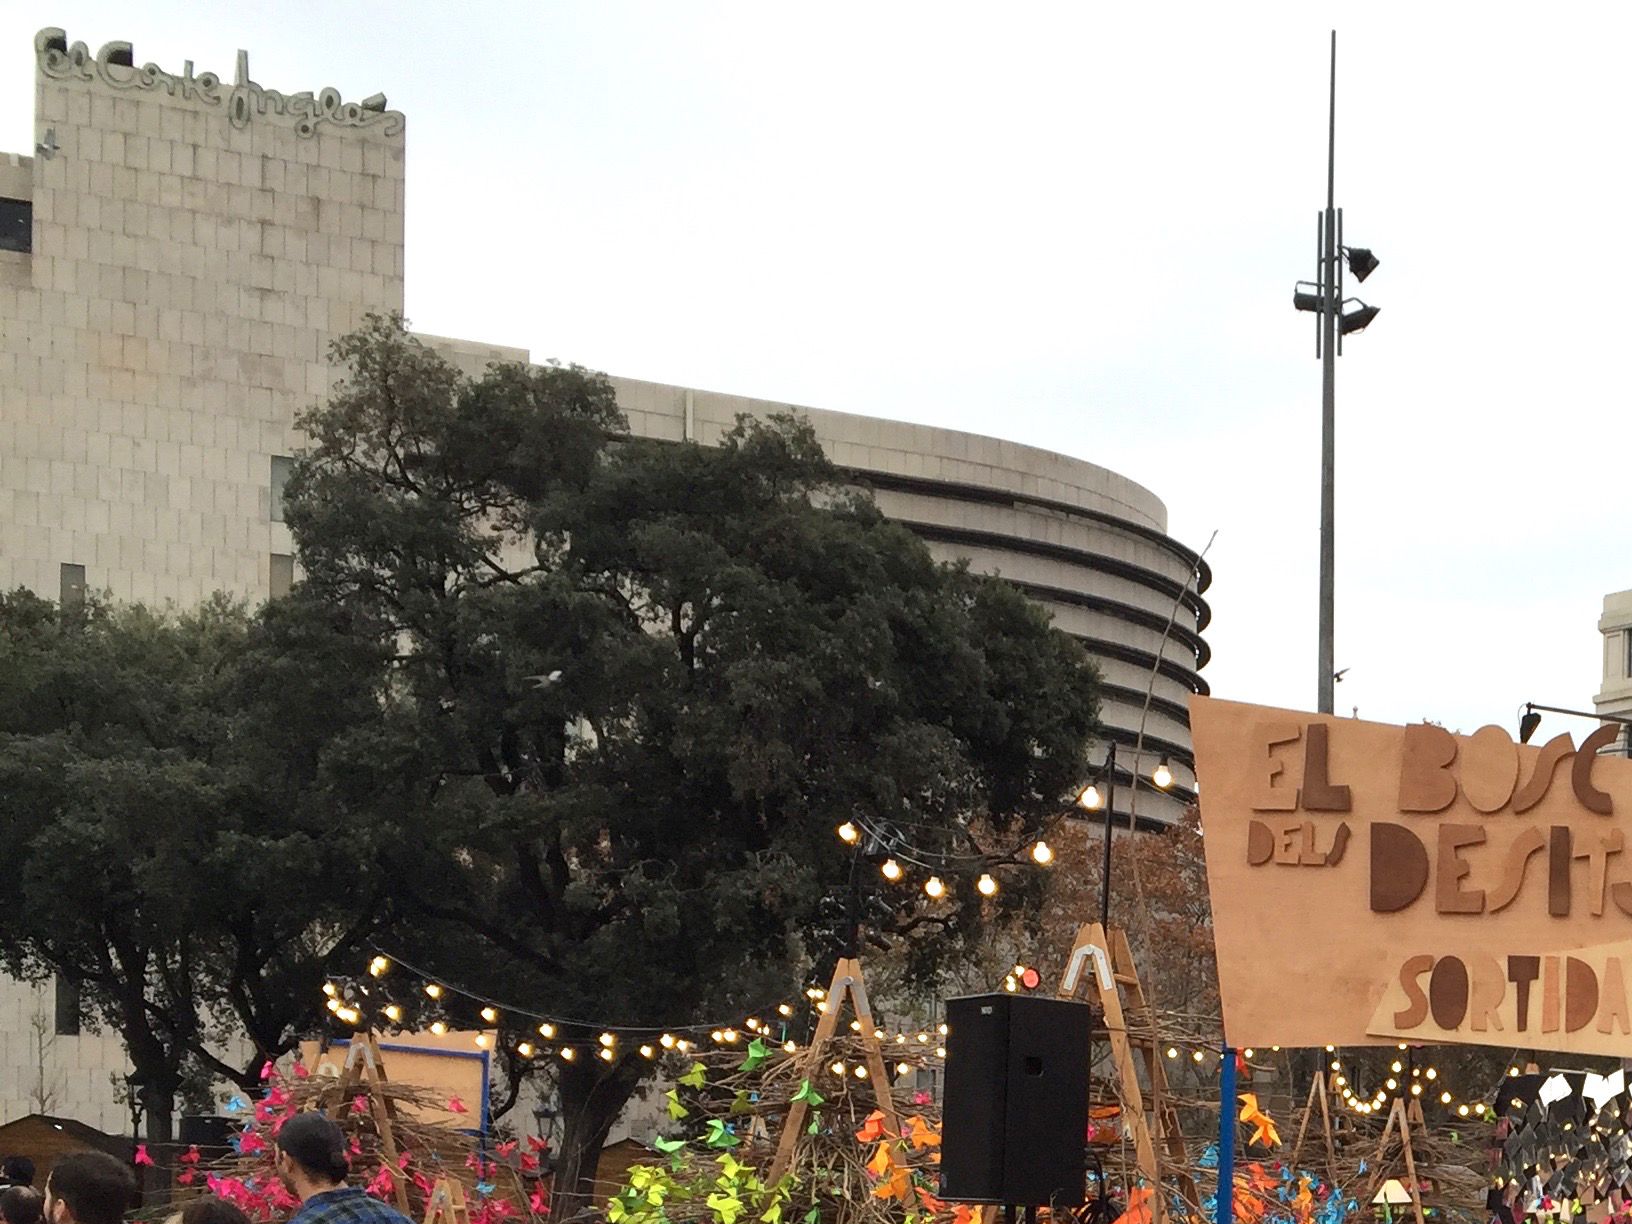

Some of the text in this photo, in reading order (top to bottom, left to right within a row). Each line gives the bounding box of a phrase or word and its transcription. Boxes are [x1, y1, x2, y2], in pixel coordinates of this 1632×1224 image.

[34, 27, 93, 81] El
[97, 40, 221, 105] Corte
[1250, 722, 1622, 815] EL BOSC
[1247, 820, 1351, 867] DELS
[1394, 954, 1632, 1035] SORTIDA
